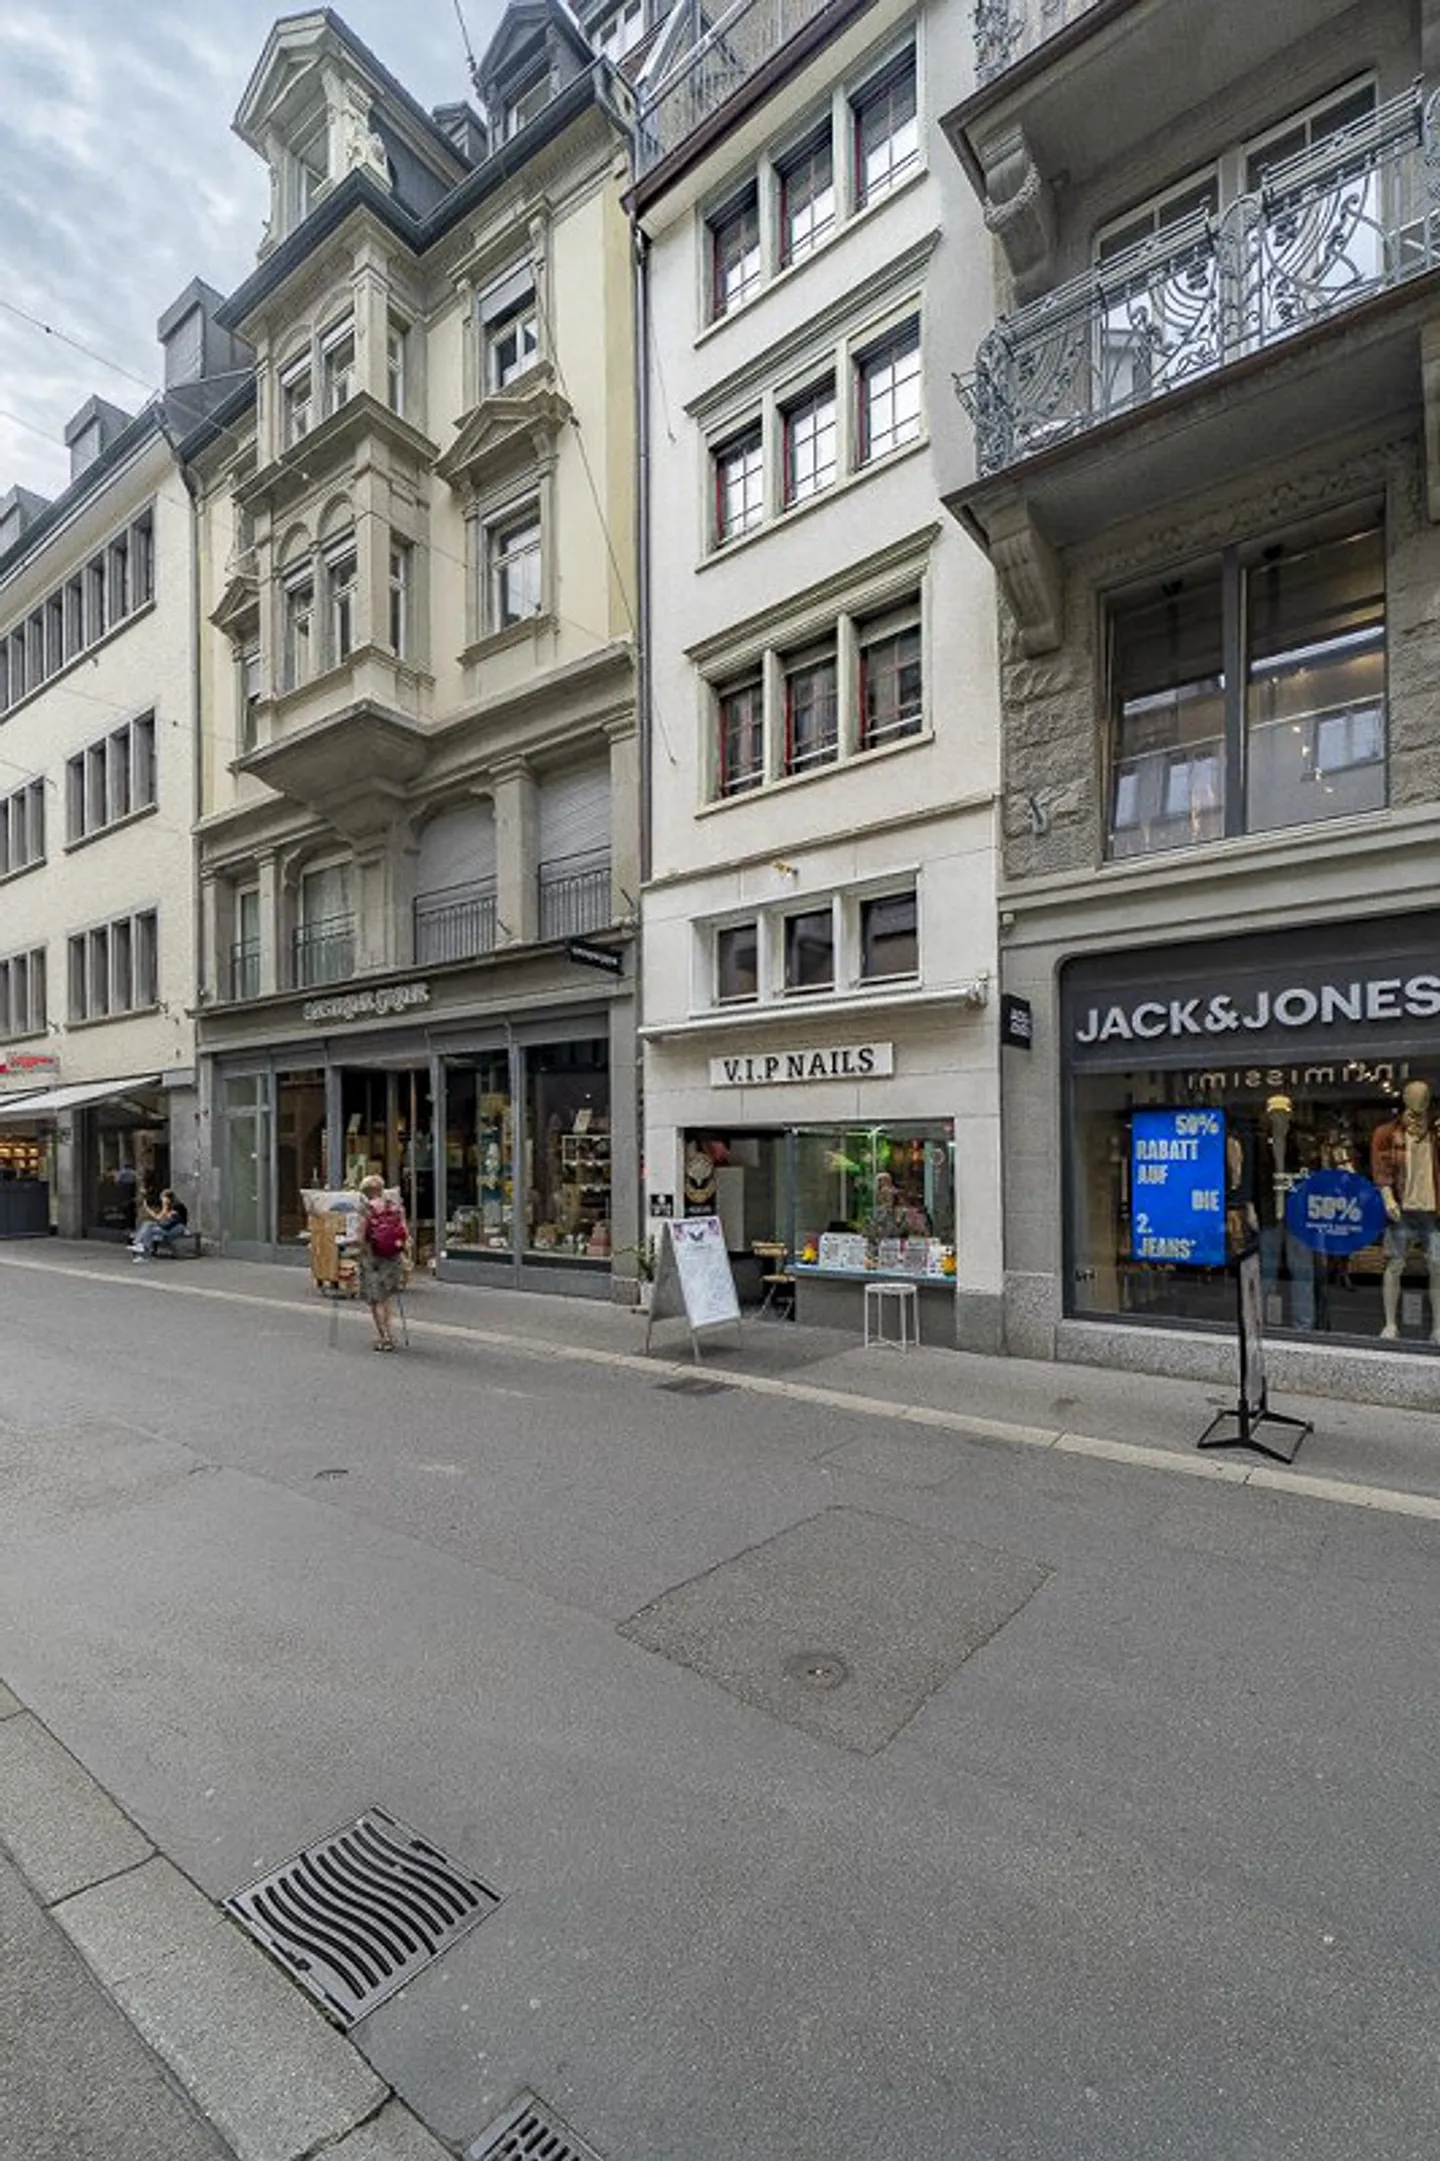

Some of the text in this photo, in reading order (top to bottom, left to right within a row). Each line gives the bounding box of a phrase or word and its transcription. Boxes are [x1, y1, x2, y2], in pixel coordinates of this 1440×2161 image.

[1077, 976, 1440, 1042] JACK&JONES
[724, 1048, 875, 1082] V.I.P NAILS
[1175, 1113, 1220, 1136] 50%
[1136, 1139, 1199, 1161] RABATT
[1137, 1164, 1168, 1185] AUF
[1191, 1189, 1220, 1212] DIE
[1307, 1194, 1363, 1222] 50%
[1136, 1213, 1153, 1233] 2.
